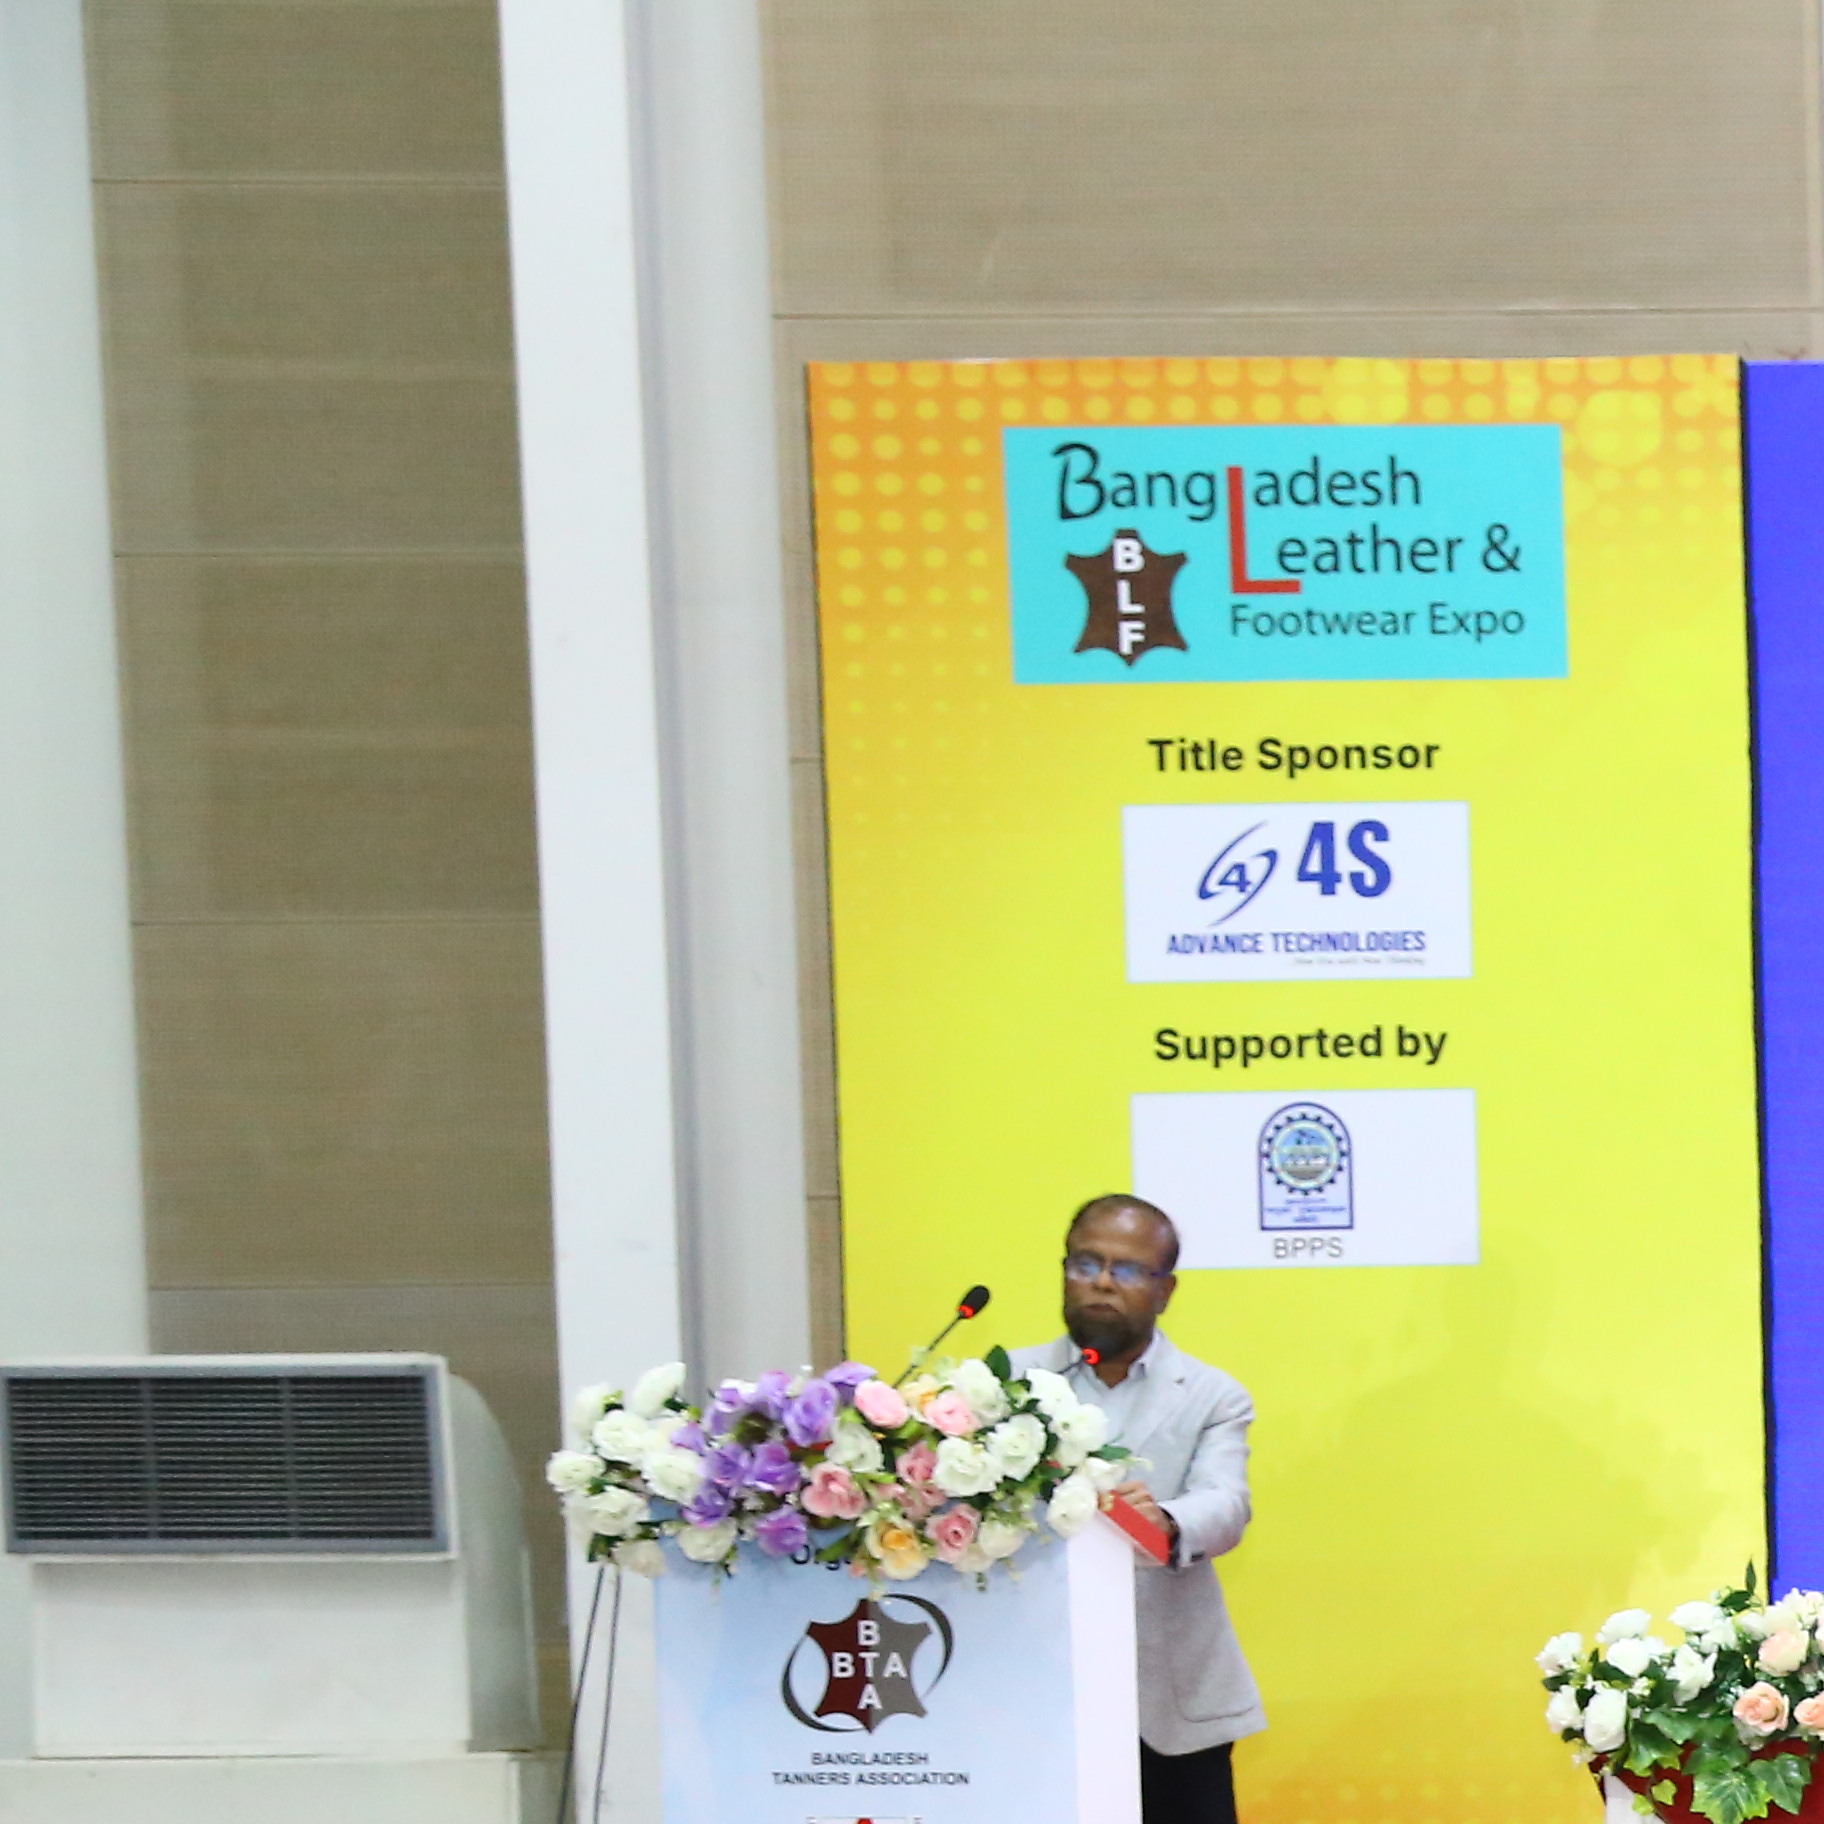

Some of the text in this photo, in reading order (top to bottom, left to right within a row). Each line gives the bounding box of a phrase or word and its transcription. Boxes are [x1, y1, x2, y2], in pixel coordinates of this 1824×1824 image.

[1480, 523, 1521, 574] &
[1230, 601, 1526, 644] Footwear Expo
[1147, 737, 1441, 780] Title Sponsor
[1296, 819, 1392, 898] 4S
[1166, 930, 1426, 955] ADVANCE TECHNOLOGIES
[1155, 1024, 1448, 1069] Supported by
[1273, 1236, 1343, 1260] BPPS
[832, 1651, 907, 1678] BTA
[810, 1751, 929, 1766] BANGLADESH
[771, 1771, 970, 1786] TANNERS ASSOCIATION
